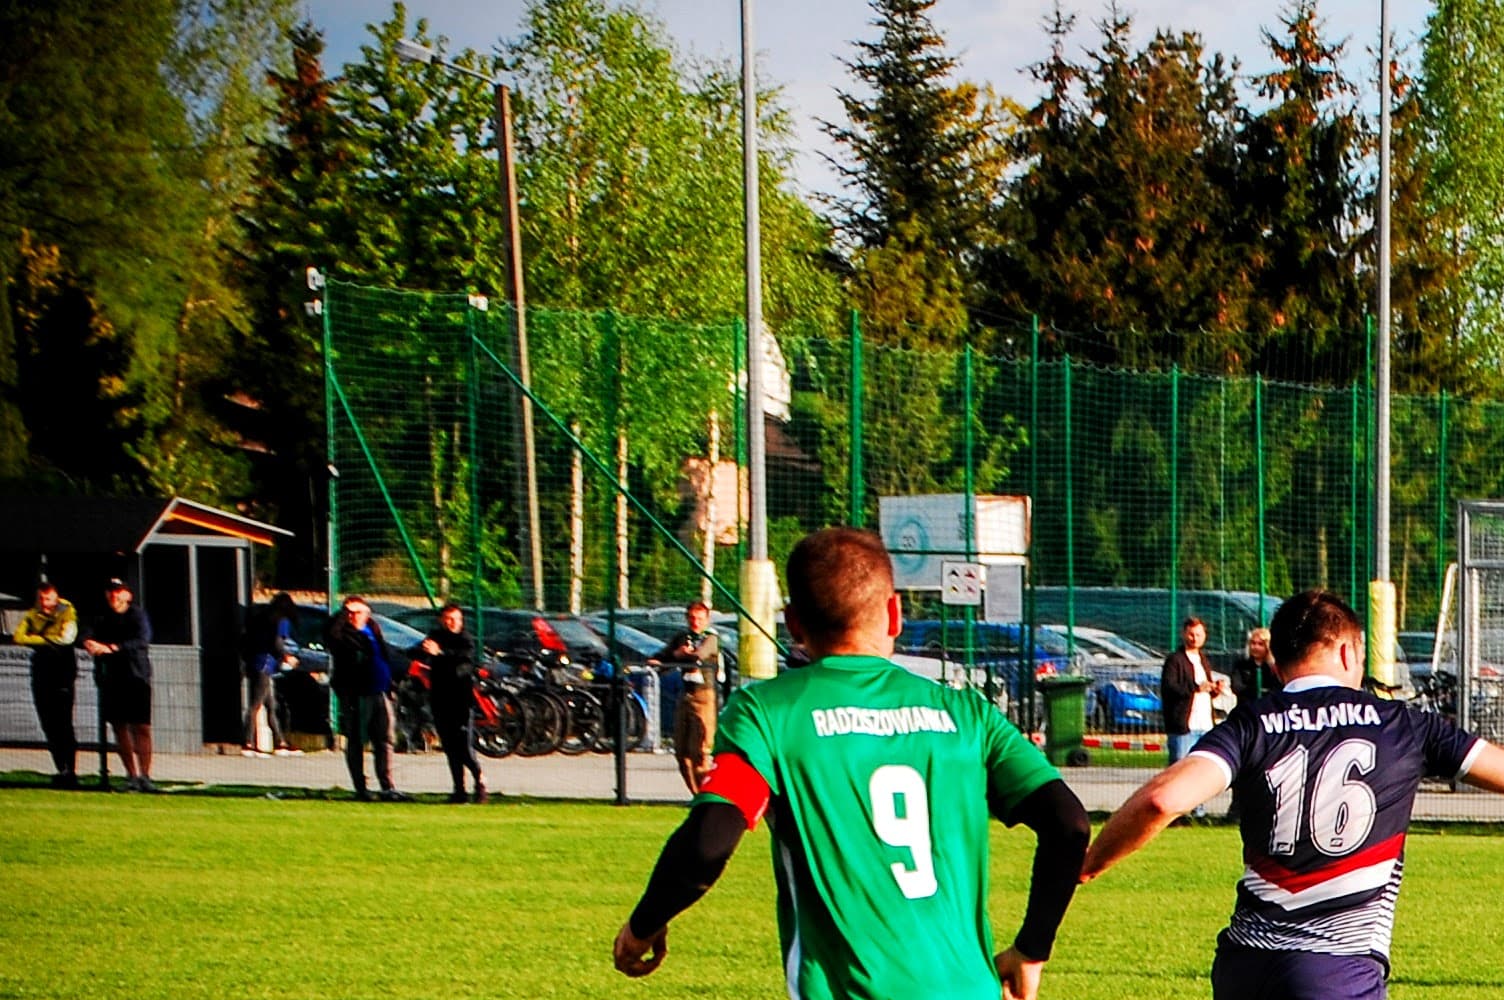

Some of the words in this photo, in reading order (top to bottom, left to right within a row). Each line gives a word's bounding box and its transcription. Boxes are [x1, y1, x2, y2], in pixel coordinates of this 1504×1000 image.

[1261, 703, 1381, 734] WIŚLANKA
[869, 765, 938, 899] 9
[1265, 738, 1377, 857] 16
